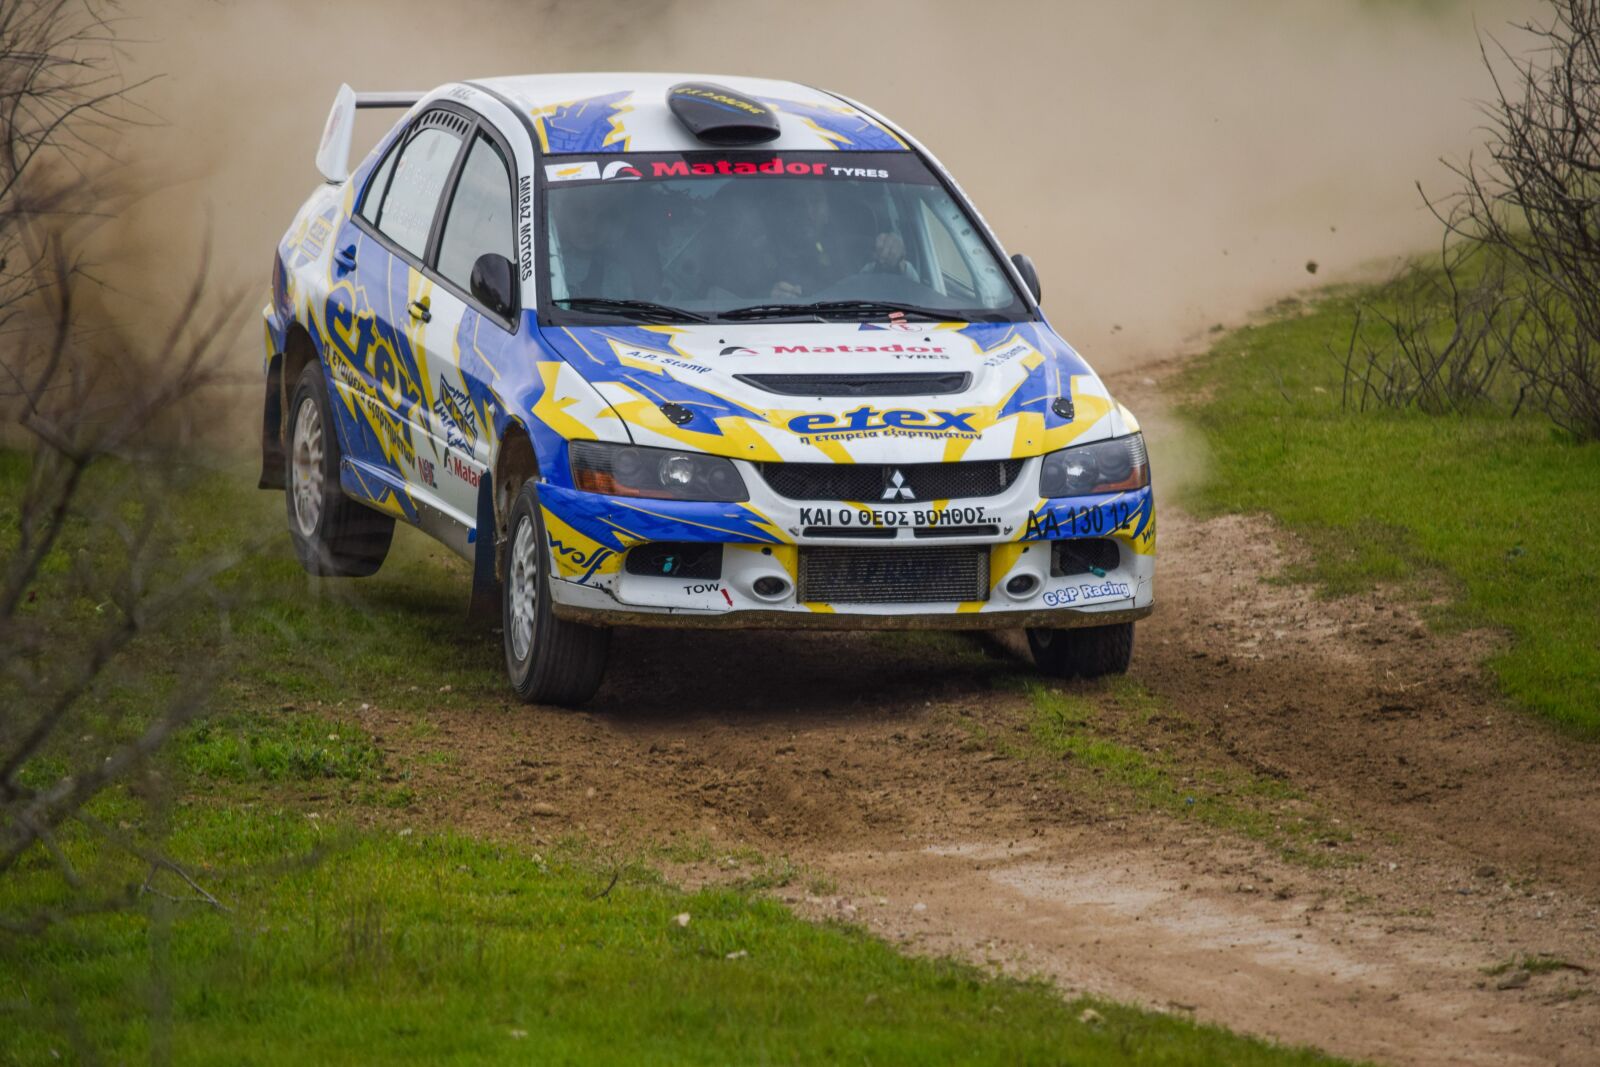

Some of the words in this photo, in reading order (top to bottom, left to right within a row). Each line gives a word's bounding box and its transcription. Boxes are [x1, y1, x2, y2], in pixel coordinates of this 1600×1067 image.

[651, 157, 827, 177] Matador
[831, 166, 889, 178] TYRES
[519, 175, 532, 223] AMIRAZ
[520, 222, 533, 282] MOTORS
[772, 343, 946, 354] Matador
[660, 358, 713, 375] Stamp
[787, 406, 978, 434] etex
[800, 436, 811, 445] η
[453, 456, 484, 489] Mata
[800, 507, 832, 526] ΚΑΙ
[838, 507, 853, 526] Ο
[858, 509, 910, 526] ΘΕΟΣ
[1025, 509, 1060, 538] AA
[1067, 504, 1104, 535] 130
[1110, 501, 1131, 531] 12
[683, 583, 719, 595] TOW
[1043, 586, 1079, 607] G&P
[1080, 581, 1131, 599] Racing
